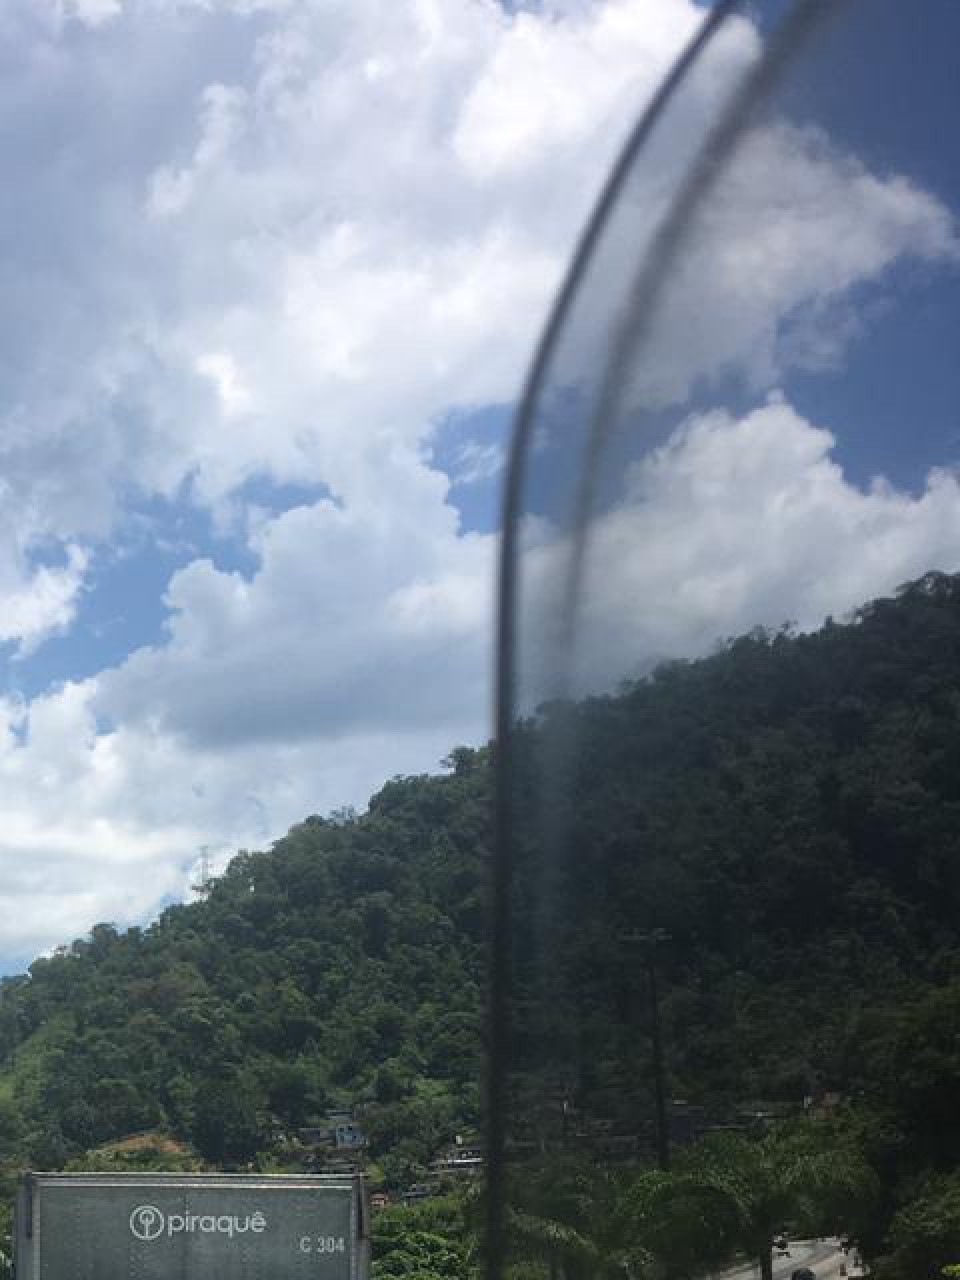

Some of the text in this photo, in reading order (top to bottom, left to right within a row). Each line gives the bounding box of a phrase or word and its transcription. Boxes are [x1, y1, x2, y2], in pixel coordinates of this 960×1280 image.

[167, 1210, 268, 1239] piraquê
[298, 1235, 346, 1253] C 304
